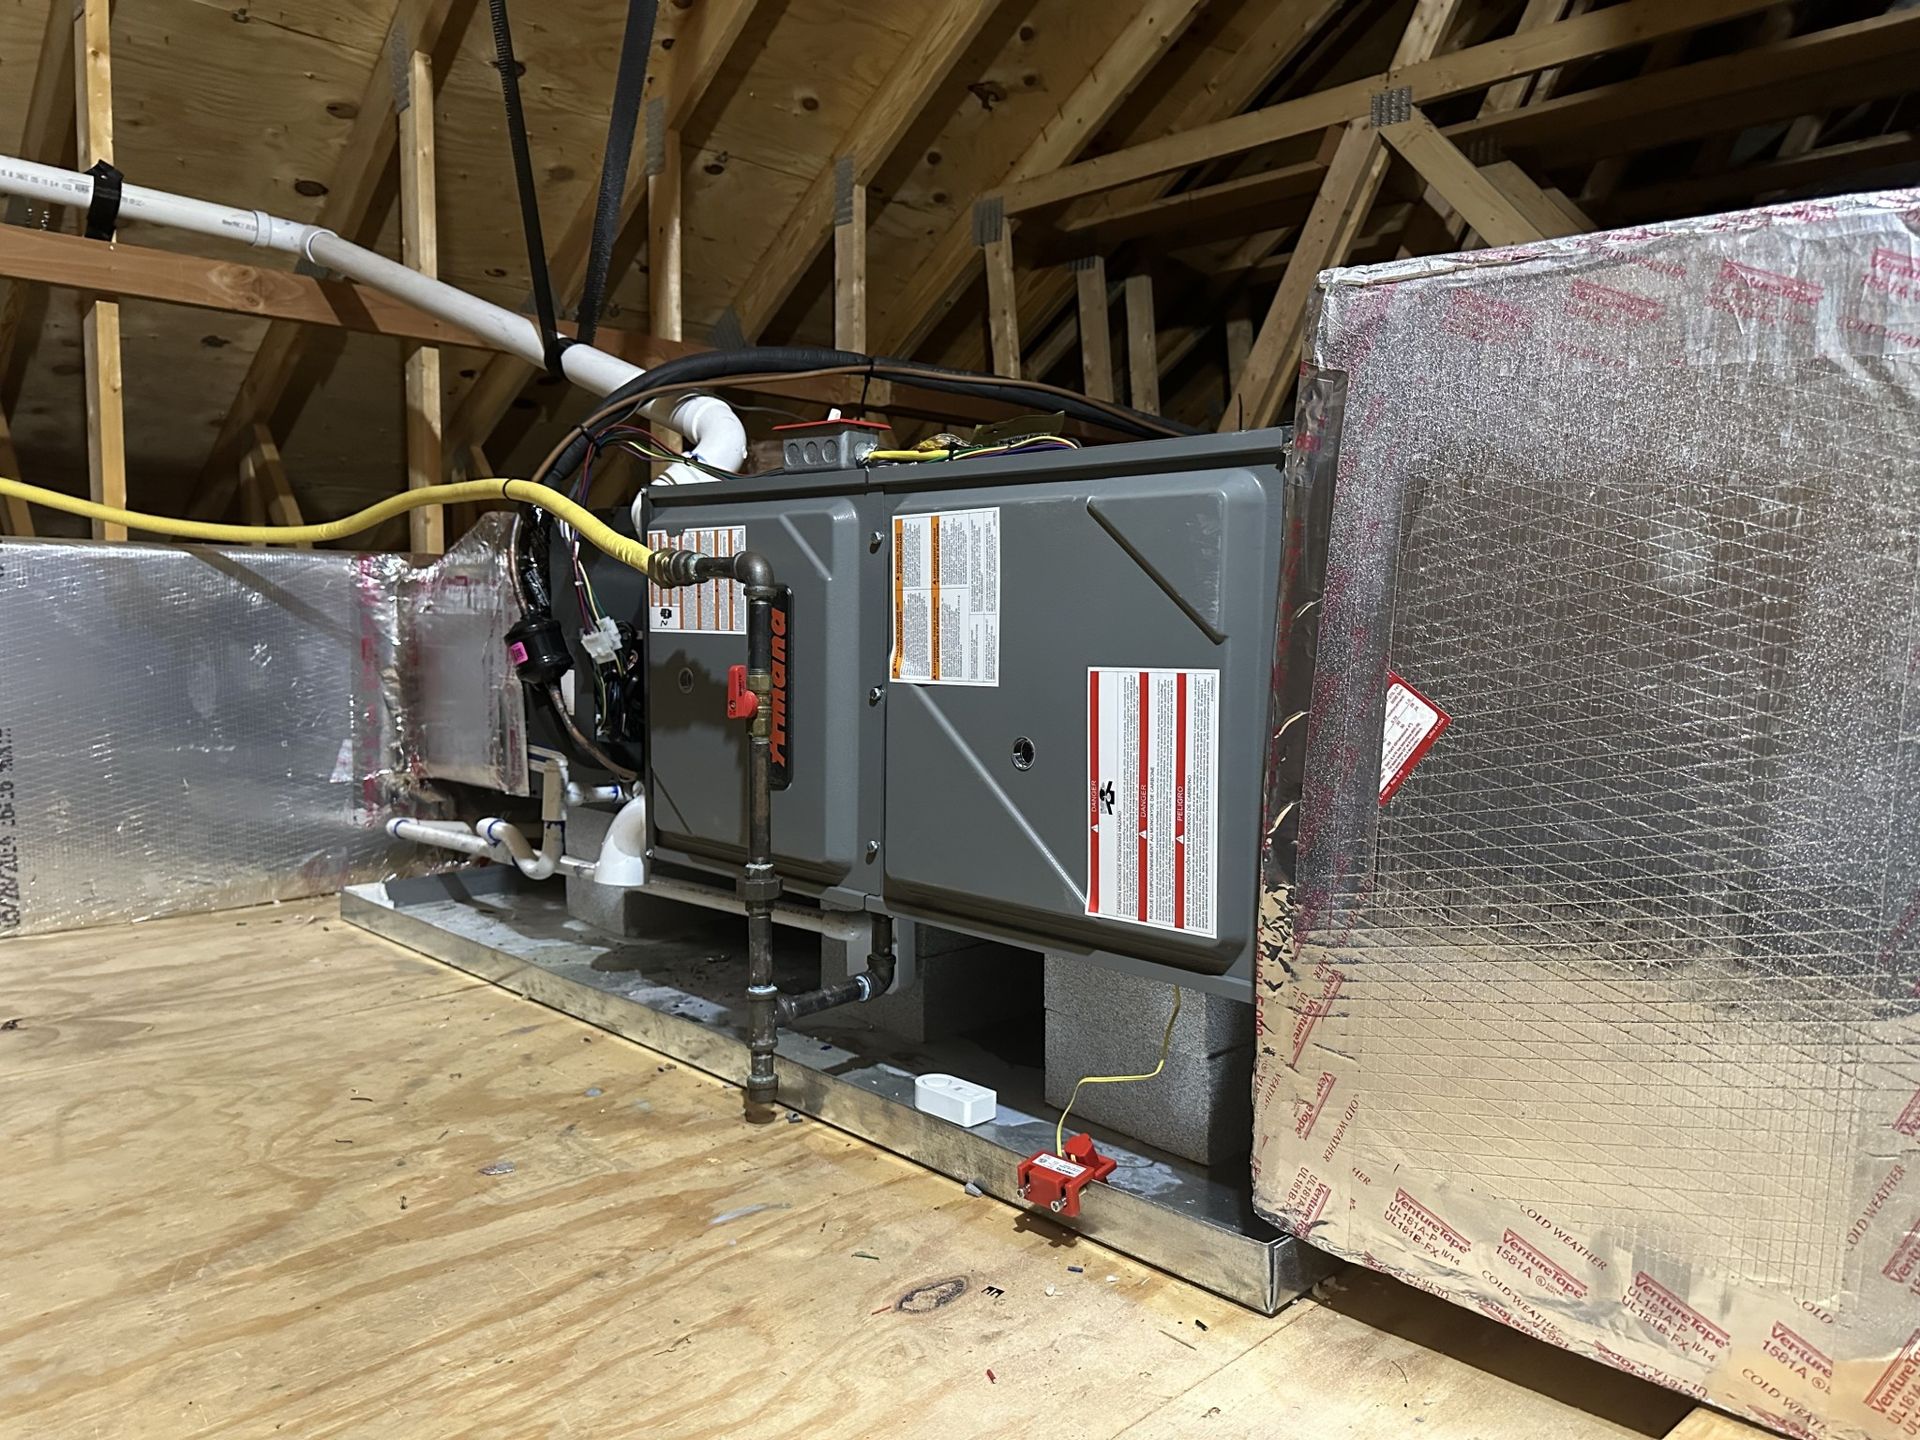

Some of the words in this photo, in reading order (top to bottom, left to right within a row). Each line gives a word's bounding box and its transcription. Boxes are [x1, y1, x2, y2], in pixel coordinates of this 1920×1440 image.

[768, 606, 787, 768] Amana
[1090, 779, 1098, 813] DANGER
[1323, 1119, 1350, 1163] WEATHER
[1863, 1164, 1907, 1222] WEATHER
[1384, 1210, 1439, 1259] UL181B-FX
[1388, 1201, 1438, 1243] UL181A-P
[1394, 1191, 1472, 1254] VentureTape
[1496, 1245, 1532, 1279] 1581A
[1502, 1233, 1588, 1299] VentureTape
[1553, 1226, 1608, 1271] WEATHER
[1481, 1269, 1512, 1297] COLD
[1621, 1294, 1692, 1352] UL181B-FX
[1627, 1285, 1688, 1333] UL181A-P
[1634, 1275, 1731, 1349] VentureTape
[1742, 1367, 1781, 1399] COLD
[1762, 1340, 1807, 1380] 1581A
